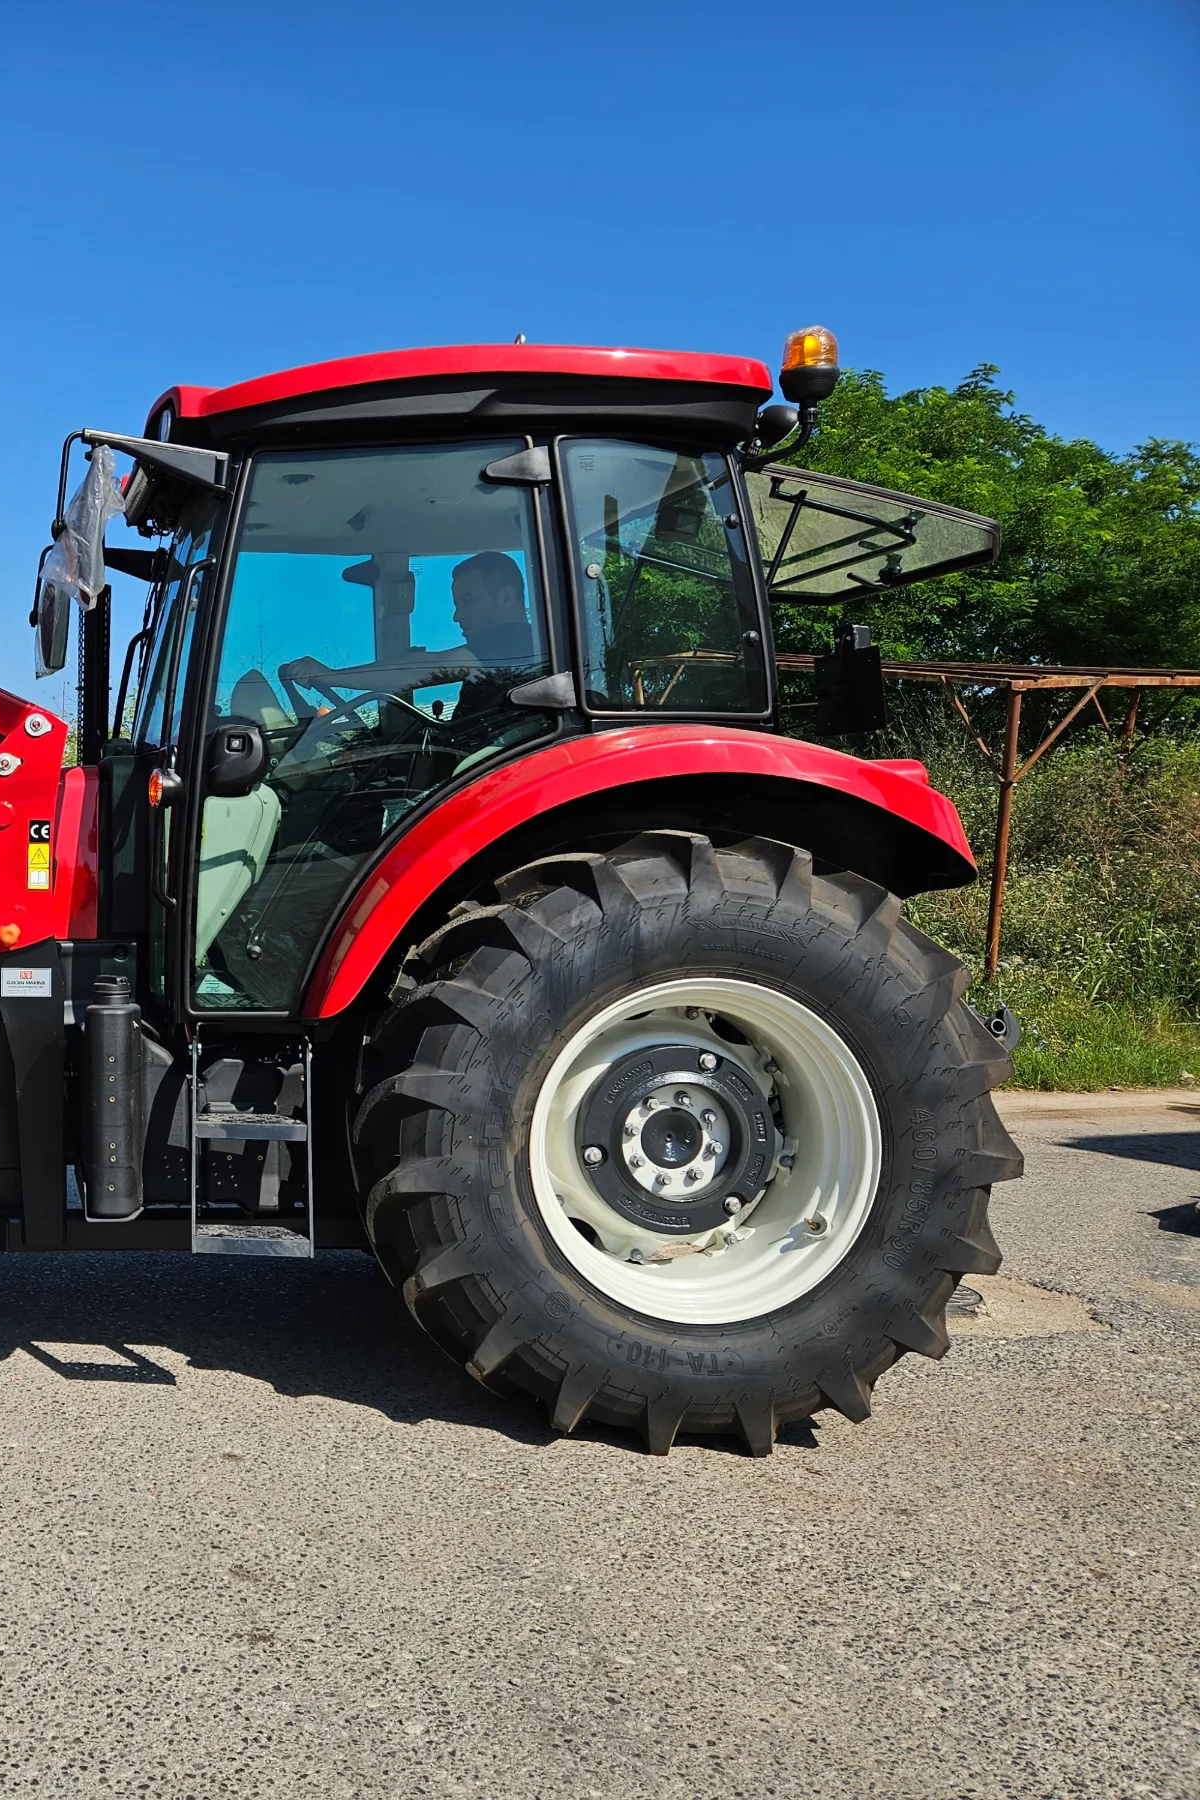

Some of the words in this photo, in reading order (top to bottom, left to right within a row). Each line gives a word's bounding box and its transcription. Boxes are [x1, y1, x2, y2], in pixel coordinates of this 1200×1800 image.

[30, 823, 50, 840] CE
[721, 917, 778, 934] ROTATION
[701, 943, 737, 952] RADIAL
[882, 1108, 938, 1269] 460/85R30
[627, 1342, 726, 1376] TA-110
